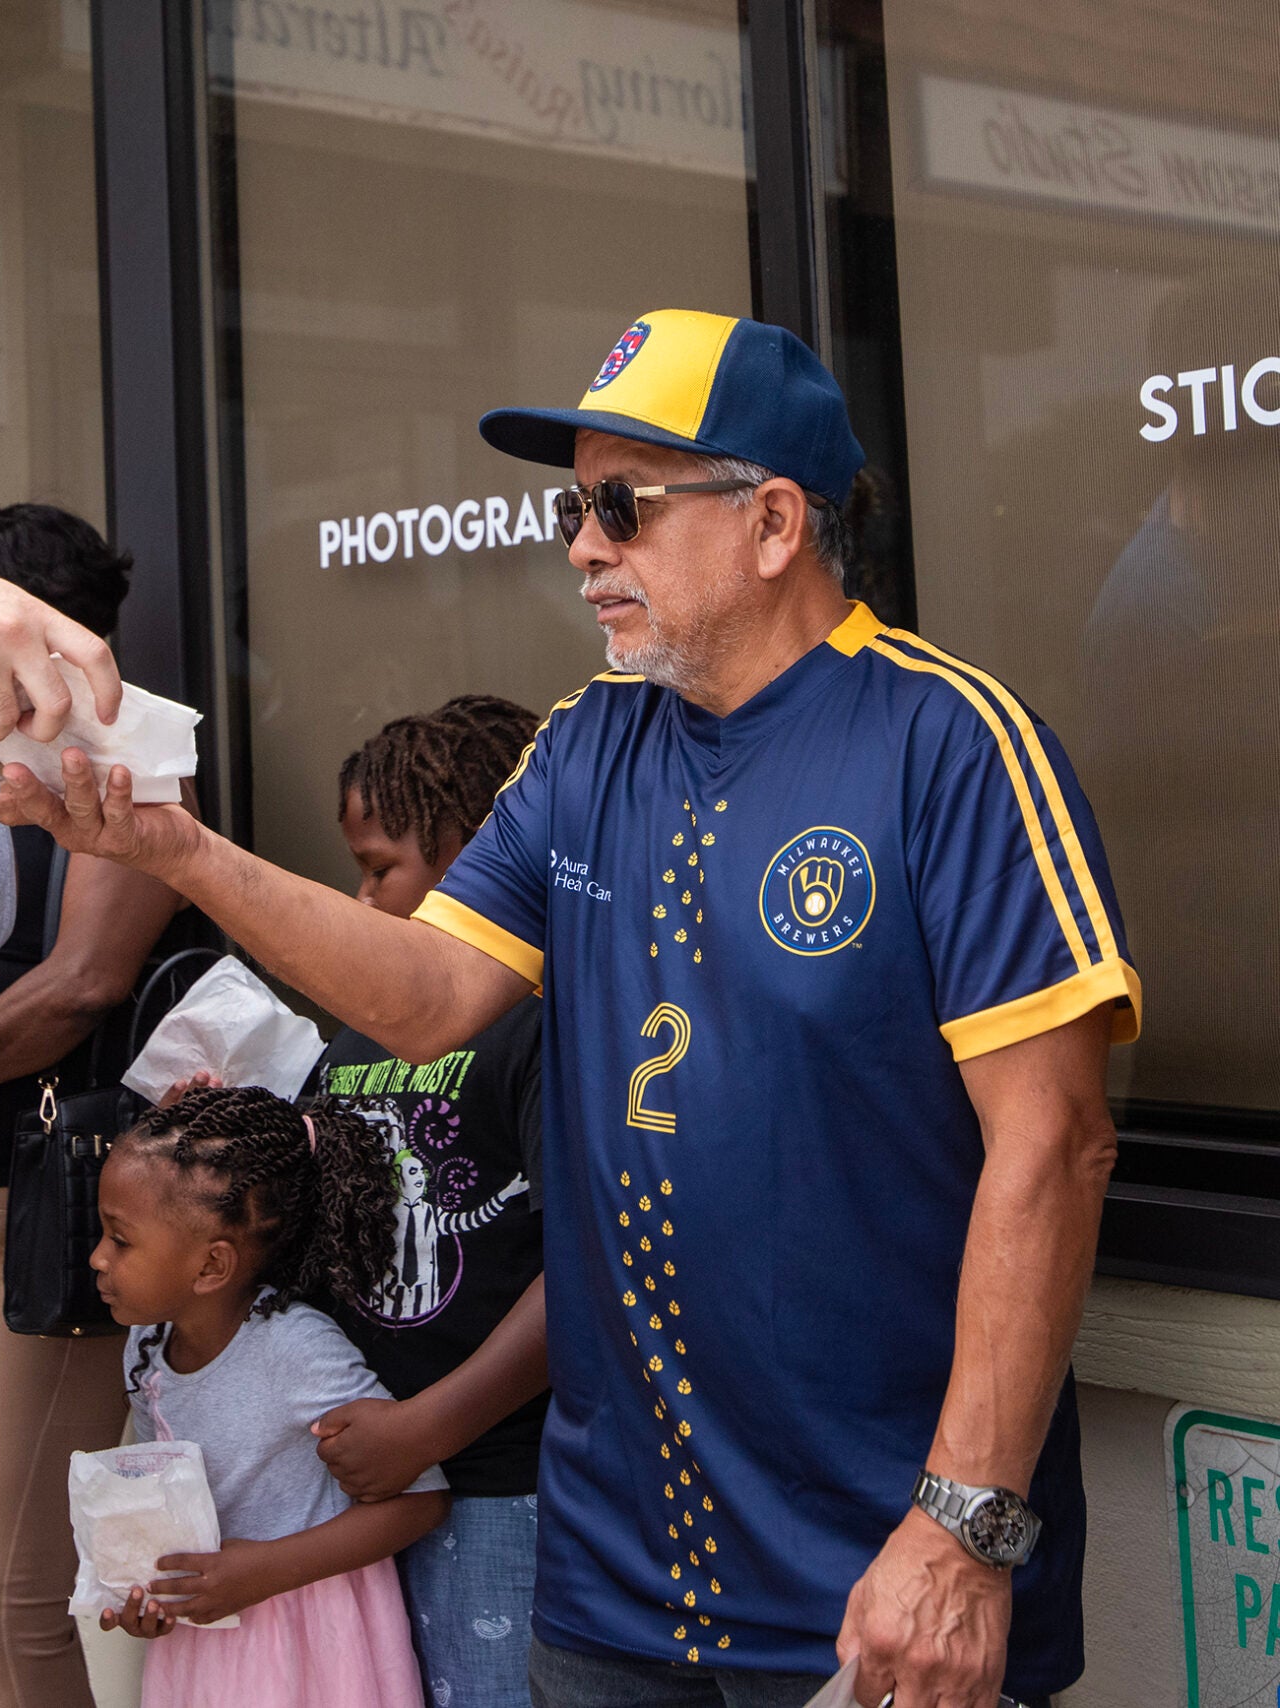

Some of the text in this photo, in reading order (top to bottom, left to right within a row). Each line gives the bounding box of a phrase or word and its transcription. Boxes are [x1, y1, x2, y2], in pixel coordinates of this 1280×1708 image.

[320, 485, 578, 569] PHOTOGRAP
[558, 856, 589, 875] Aura
[777, 837, 863, 878] MILWAUKEE
[774, 912, 853, 945] BREWERS
[626, 1002, 691, 1134] 2
[1207, 1468, 1280, 1555] RE
